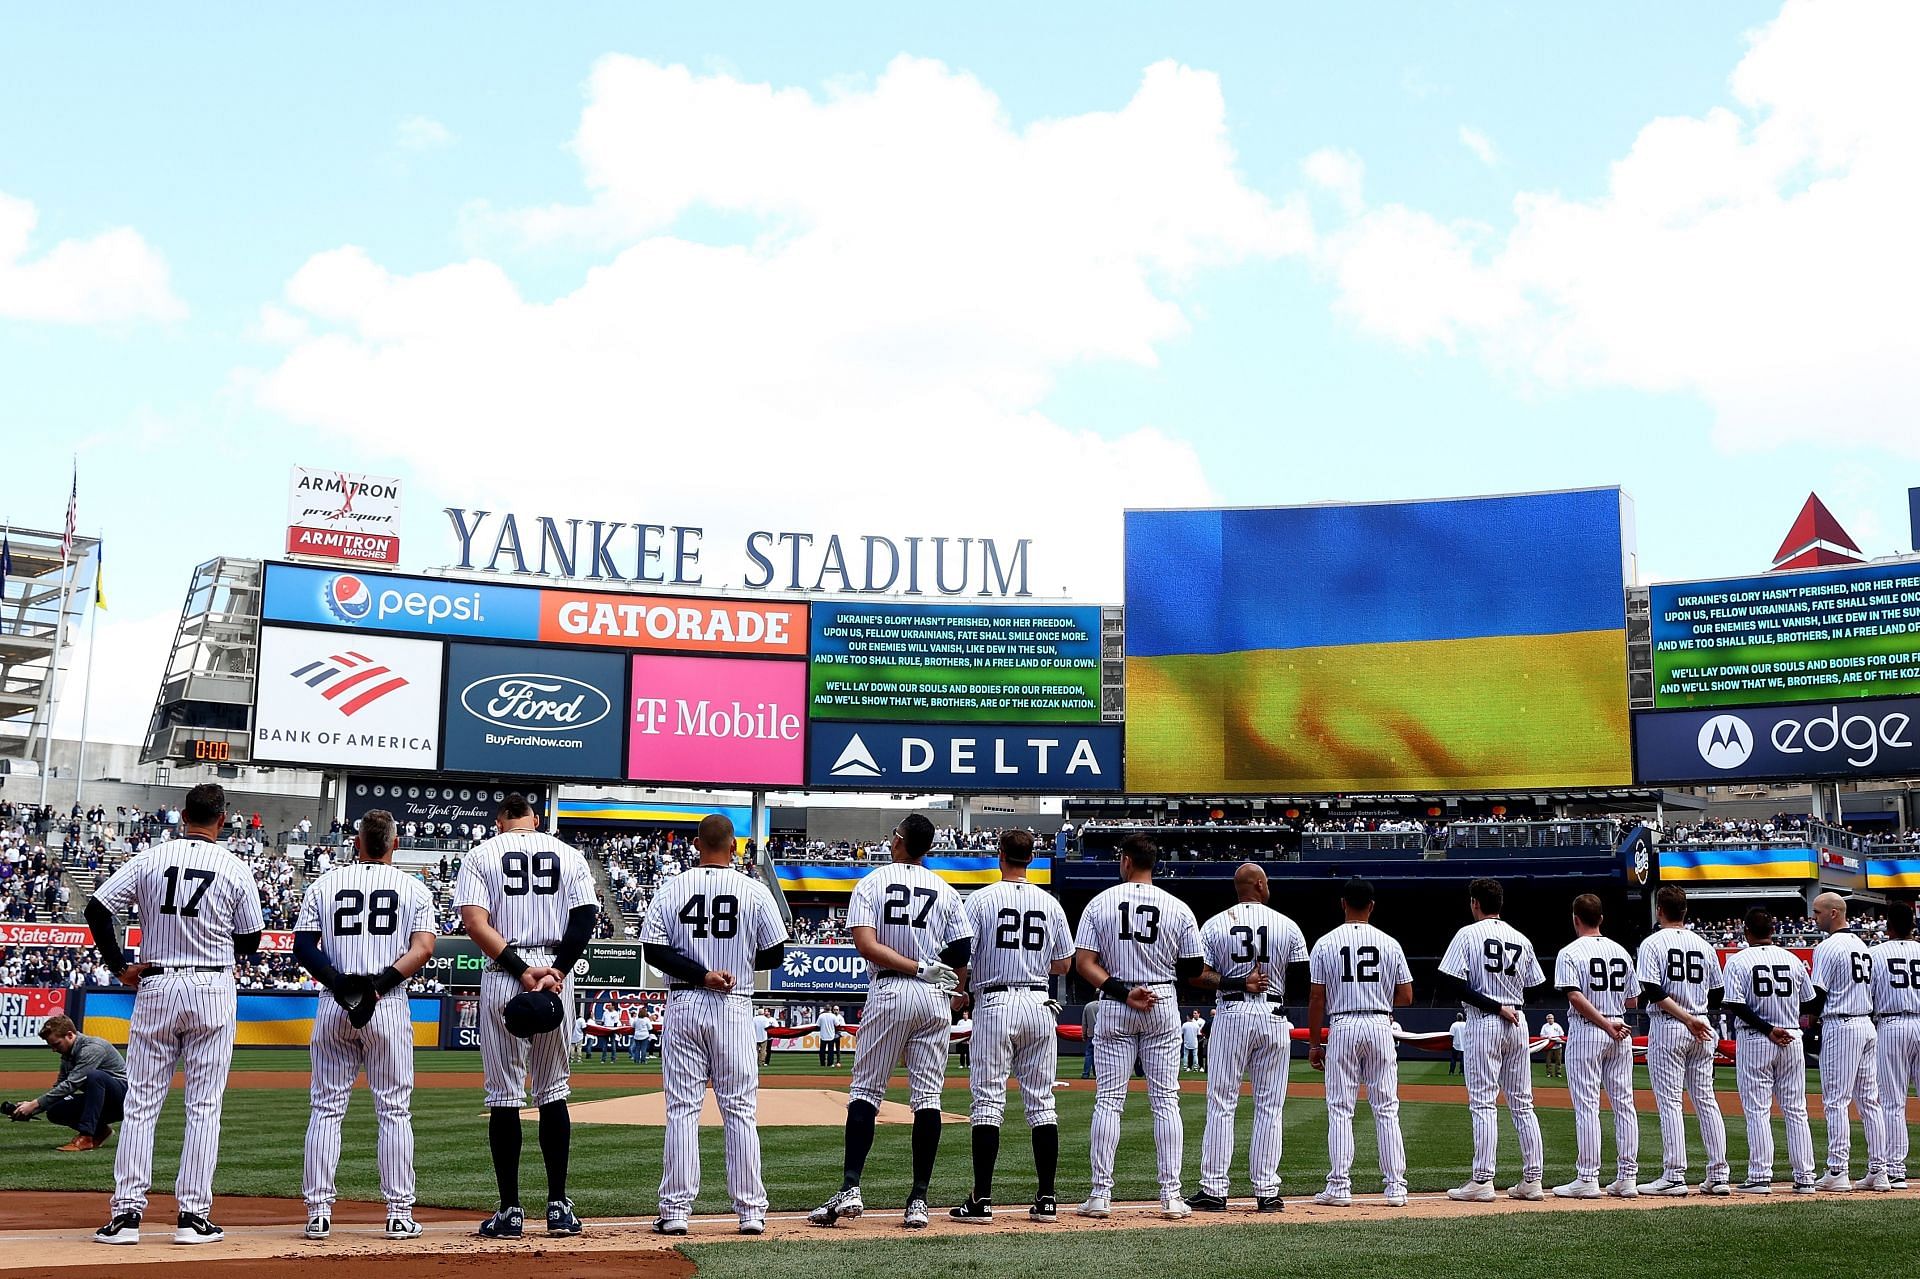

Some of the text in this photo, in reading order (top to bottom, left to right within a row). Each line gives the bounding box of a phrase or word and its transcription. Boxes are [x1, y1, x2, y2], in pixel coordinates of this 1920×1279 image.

[298, 476, 398, 500] ARMITRON
[300, 531, 388, 551] ARMITRON
[344, 548, 386, 559] WATCHES
[443, 508, 1033, 596] YANKEE STADIUM
[378, 590, 480, 624] pepsi
[1665, 594, 1899, 622] UPON US, FELLOW UKRAINIANS, FATE SHALL SMILE
[1678, 580, 1893, 606] UKRAINE'S GLORY HASN'T PERISHED, NOR HER
[558, 602, 790, 644] GATORADE
[824, 628, 848, 636] UPON
[850, 629, 864, 638] US,
[866, 630, 899, 638] FELLOW
[901, 630, 956, 640] UKRAINIANS,
[958, 631, 978, 640] FATE
[979, 632, 1007, 640] SHALL
[837, 615, 1075, 628] UKRAINE'S GLORY HASN'T PERISHED, NOR HER FREEDOM.
[1658, 623, 1906, 650] AND TOO SHALL RULE, BROTHERS, FREE LAND
[1693, 609, 1900, 634] OUR ENEMIES WILL VANISH, LIKE DEW THE
[815, 655, 833, 663] AND
[835, 655, 849, 664] WE
[850, 656, 867, 664] TOO
[869, 656, 896, 665] SHALL
[899, 657, 922, 666] RULE,
[925, 657, 972, 668] BROTHERS,
[993, 659, 1014, 667] FREE
[1016, 659, 1039, 667] LAND
[849, 642, 867, 650] OUR
[869, 643, 906, 651] ENEMIES
[908, 644, 928, 652] WILL
[930, 644, 964, 654] VANISH,
[966, 645, 985, 653] LIKE
[986, 645, 1006, 653] DEW
[1037, 646, 1057, 655] SUN,
[1660, 670, 1898, 694] AND WE'LL SHOW THAT WE, BROTHERS, ARE THE
[1672, 654, 1910, 678] WE'LL LAY DOWN OUR SOULS AND BODIES FOR OUR
[487, 680, 586, 723] Ford
[814, 696, 1096, 708] AND WE'LL SHOW THAT WE, BROTHERS, ARE OF THE KOZAK NATION.
[826, 682, 1085, 695] WE'LL LAY DOWN OUR SOULS AND BODIES FOR OUR FREEDOM,
[636, 698, 800, 740] T Mobile
[196, 741, 228, 759] 0:00
[258, 728, 432, 751] BANK OF AMERICA
[485, 733, 582, 749] BuyFordNow.com
[1771, 706, 1912, 767] edge
[902, 737, 1101, 775] DELTA
[406, 803, 488, 820] New York Yankees
[502, 852, 560, 896] 99
[160, 866, 216, 918] 17
[883, 884, 938, 928] 27
[334, 889, 399, 936] 28
[678, 894, 739, 939] 48
[1118, 901, 1159, 944] 13
[996, 908, 1047, 951] 26
[1230, 926, 1270, 963] 31
[1340, 946, 1379, 982] 12
[1483, 939, 1522, 976] 97
[1668, 948, 1704, 984] 86
[1851, 952, 1872, 984] 63
[782, 981, 809, 989] Business
[812, 981, 833, 991] Spend
[1589, 957, 1627, 992] 92
[1752, 965, 1793, 997] 65
